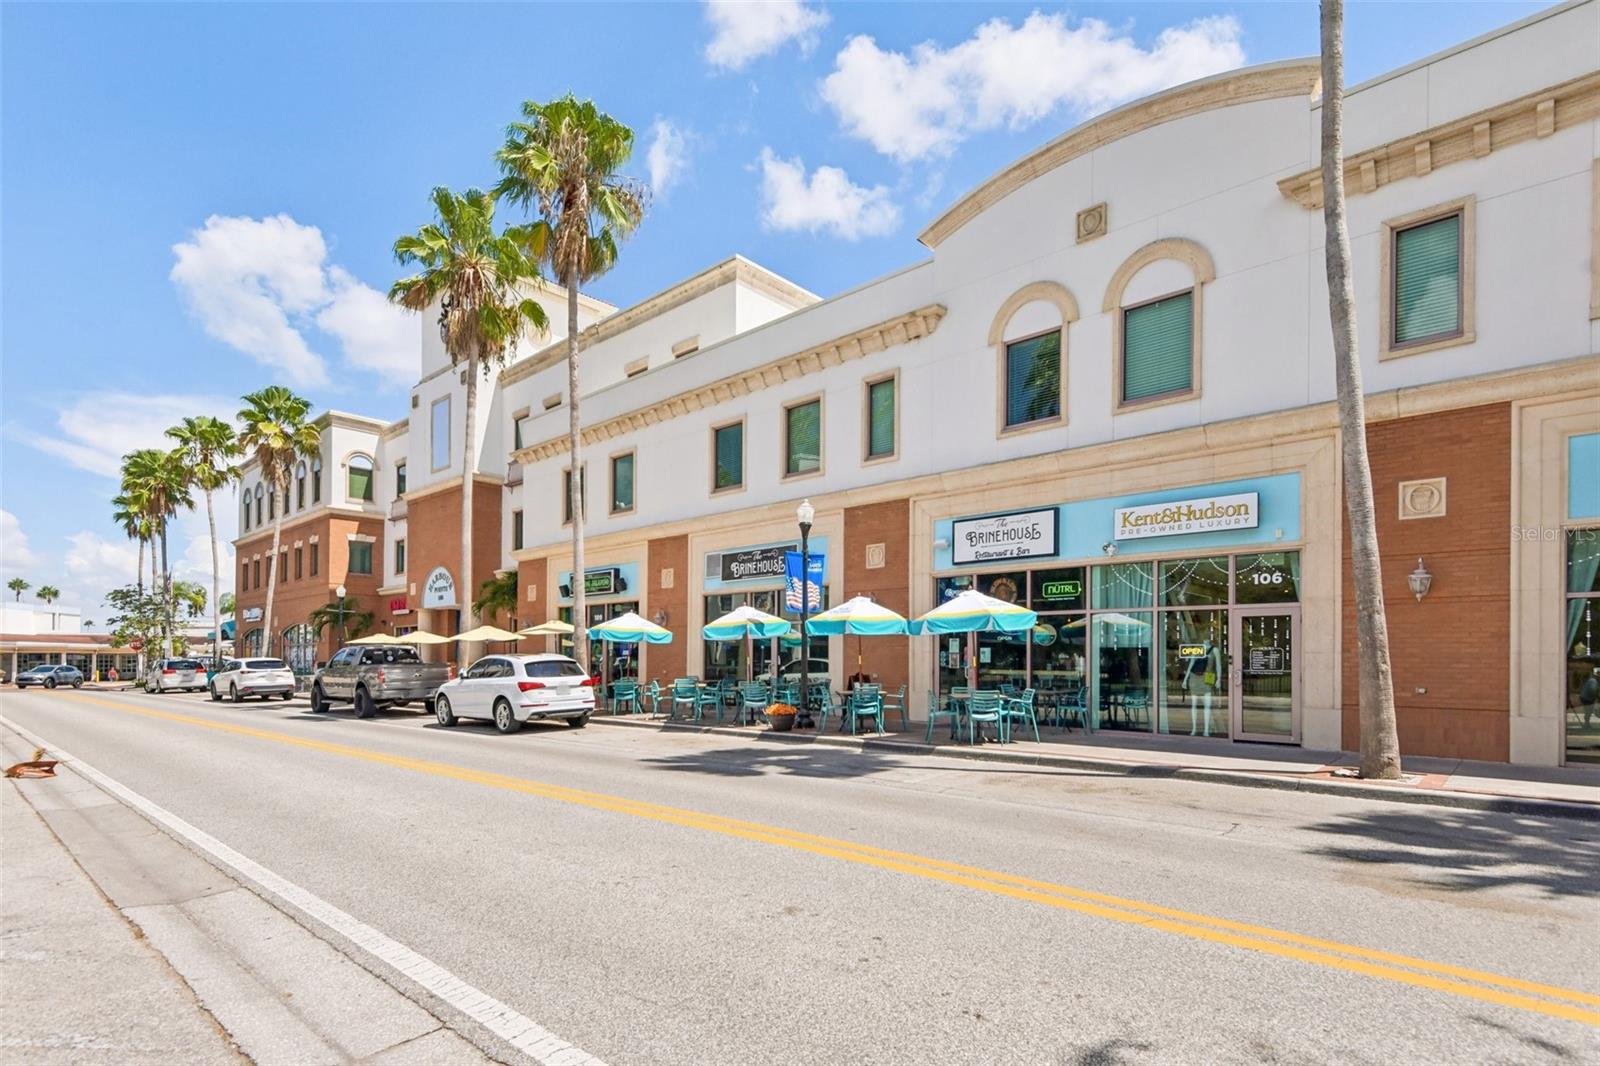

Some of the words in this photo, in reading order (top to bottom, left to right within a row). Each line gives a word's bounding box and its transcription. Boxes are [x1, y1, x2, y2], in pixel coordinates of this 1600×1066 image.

[1121, 502, 1249, 528] Kent&Hudson
[965, 523, 1041, 547] BRINEHOUSE
[1121, 523, 1191, 535] PRE-OWNED
[1199, 517, 1249, 528] LUXURY
[974, 549, 1009, 560] Restaurant
[730, 556, 785, 578] BRINEHOUSE
[1252, 572, 1283, 585] 106
[1181, 647, 1204, 655] OPEN
